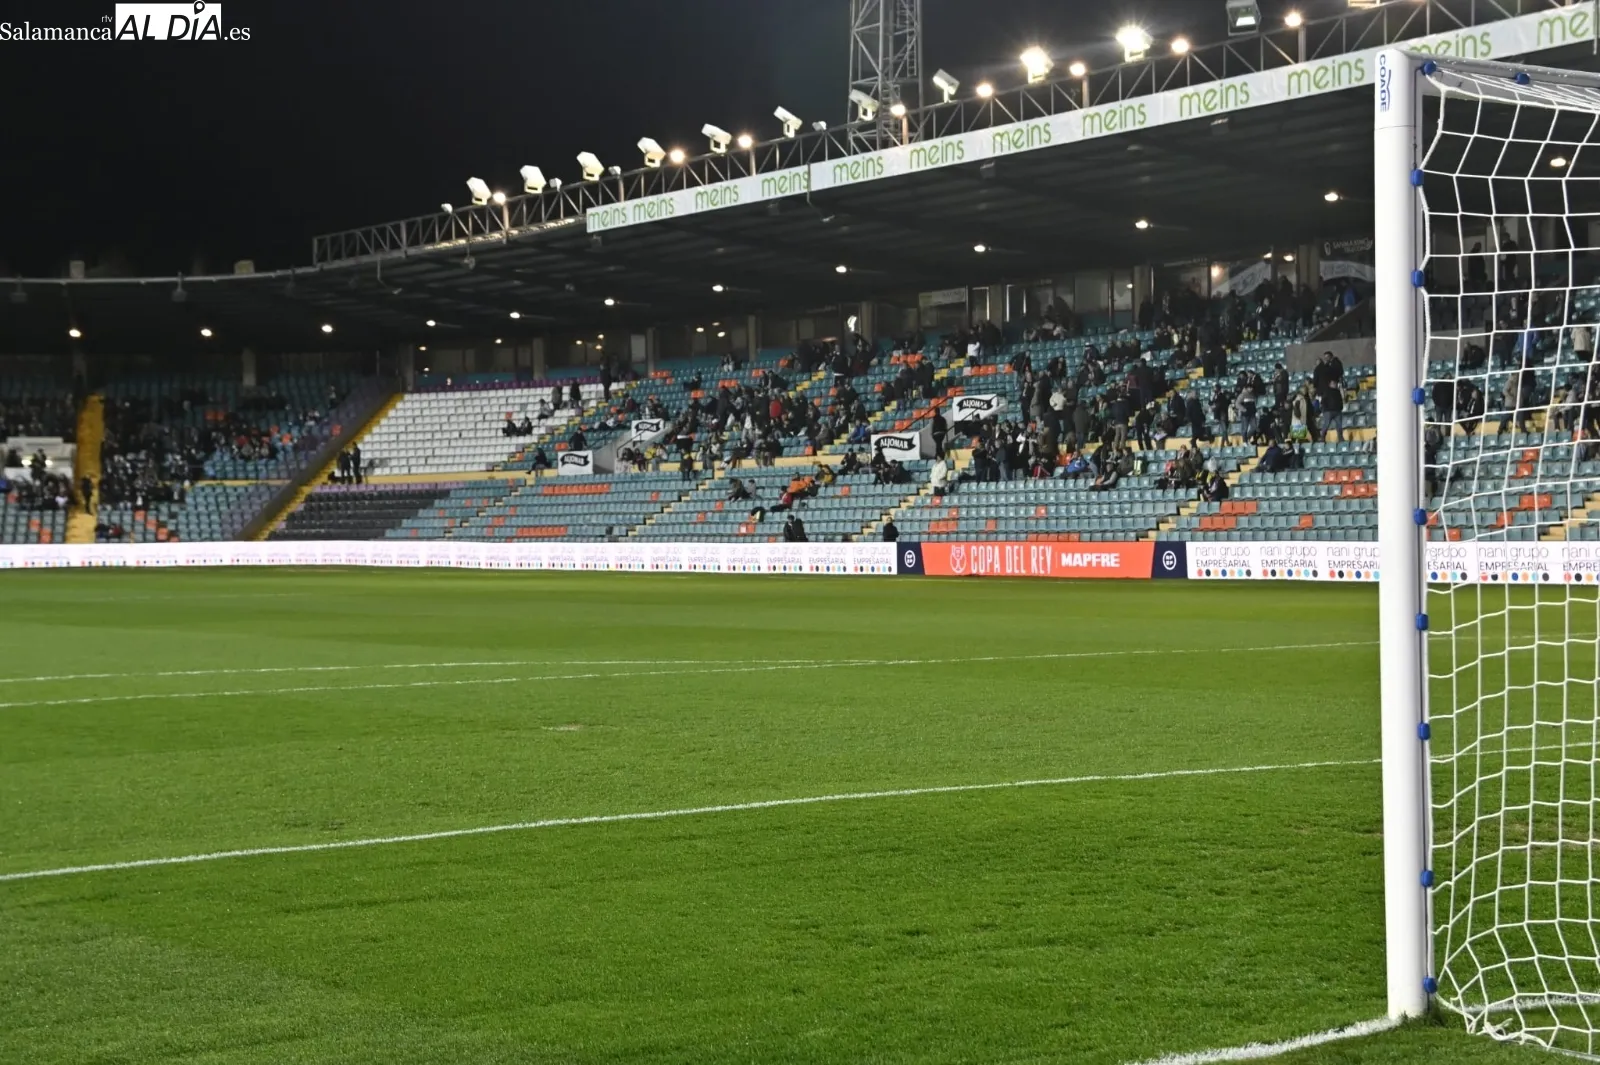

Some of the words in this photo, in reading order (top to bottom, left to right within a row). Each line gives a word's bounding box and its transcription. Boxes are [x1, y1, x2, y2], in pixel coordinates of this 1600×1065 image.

[1288, 56, 1365, 97] meins
[1179, 80, 1250, 118] meins
[1082, 103, 1147, 137] meins
[992, 121, 1052, 155] meins
[909, 140, 965, 170] meins
[833, 155, 884, 184] meins
[761, 170, 811, 198] meins
[695, 183, 740, 210] meins
[588, 206, 627, 231] meins
[633, 196, 675, 222] meins
[880, 438, 909, 450] ALJOMAR
[970, 545, 1000, 574] COPA
[1005, 545, 1026, 574] DEL
[1031, 545, 1052, 574] REY
[1061, 552, 1120, 567] MAPFRE
[1195, 545, 1217, 557] nani
[1220, 546, 1251, 560] grupo
[1260, 545, 1282, 557] nani
[1284, 546, 1317, 560] grupo
[1326, 545, 1350, 557] nani
[1353, 546, 1380, 560] grup
[1478, 546, 1506, 558] nani
[1510, 546, 1549, 561] grupo
[1562, 546, 1590, 558] nani
[1196, 559, 1252, 568] EMPRESARIAL
[1261, 559, 1318, 568] EMPRESARIAL
[1427, 561, 1467, 571] ESARIAL
[1479, 561, 1550, 571] EMPRESARIAL
